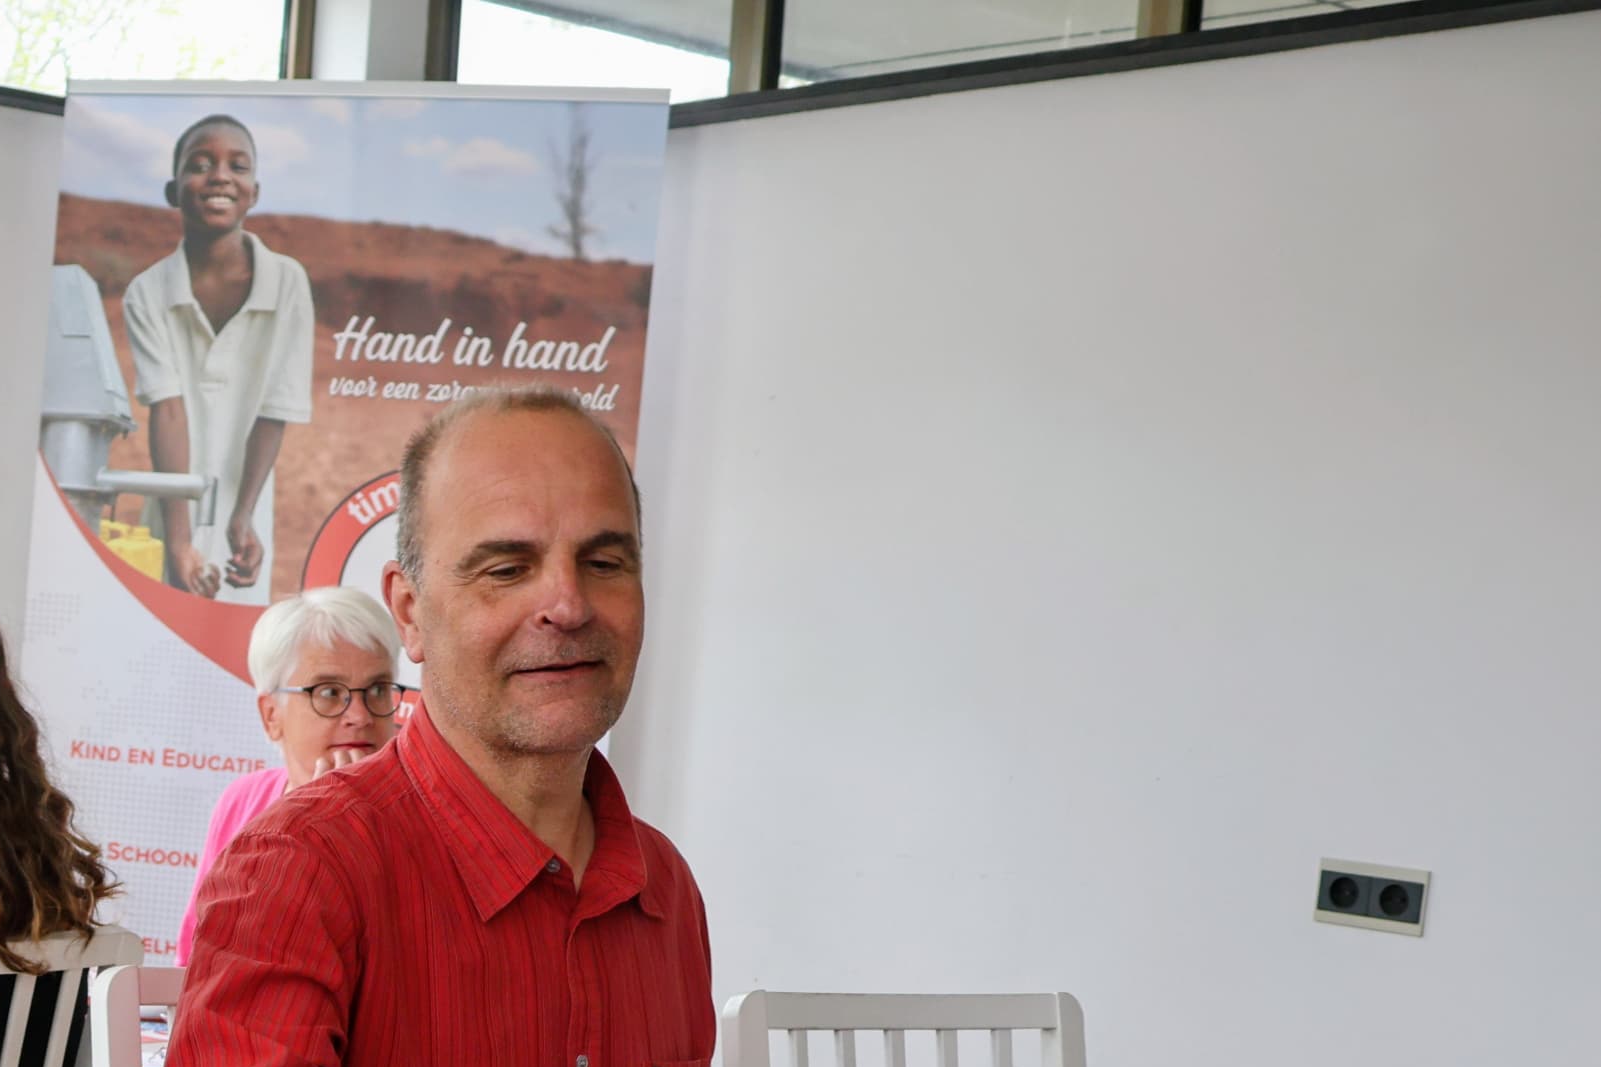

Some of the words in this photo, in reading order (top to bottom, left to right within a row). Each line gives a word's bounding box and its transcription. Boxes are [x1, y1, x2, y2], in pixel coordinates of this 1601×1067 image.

[333, 315, 452, 363] Hand
[453, 327, 493, 367] in
[502, 321, 617, 373] hand
[329, 376, 377, 398] voor
[382, 383, 420, 400] een
[347, 481, 400, 525] tim
